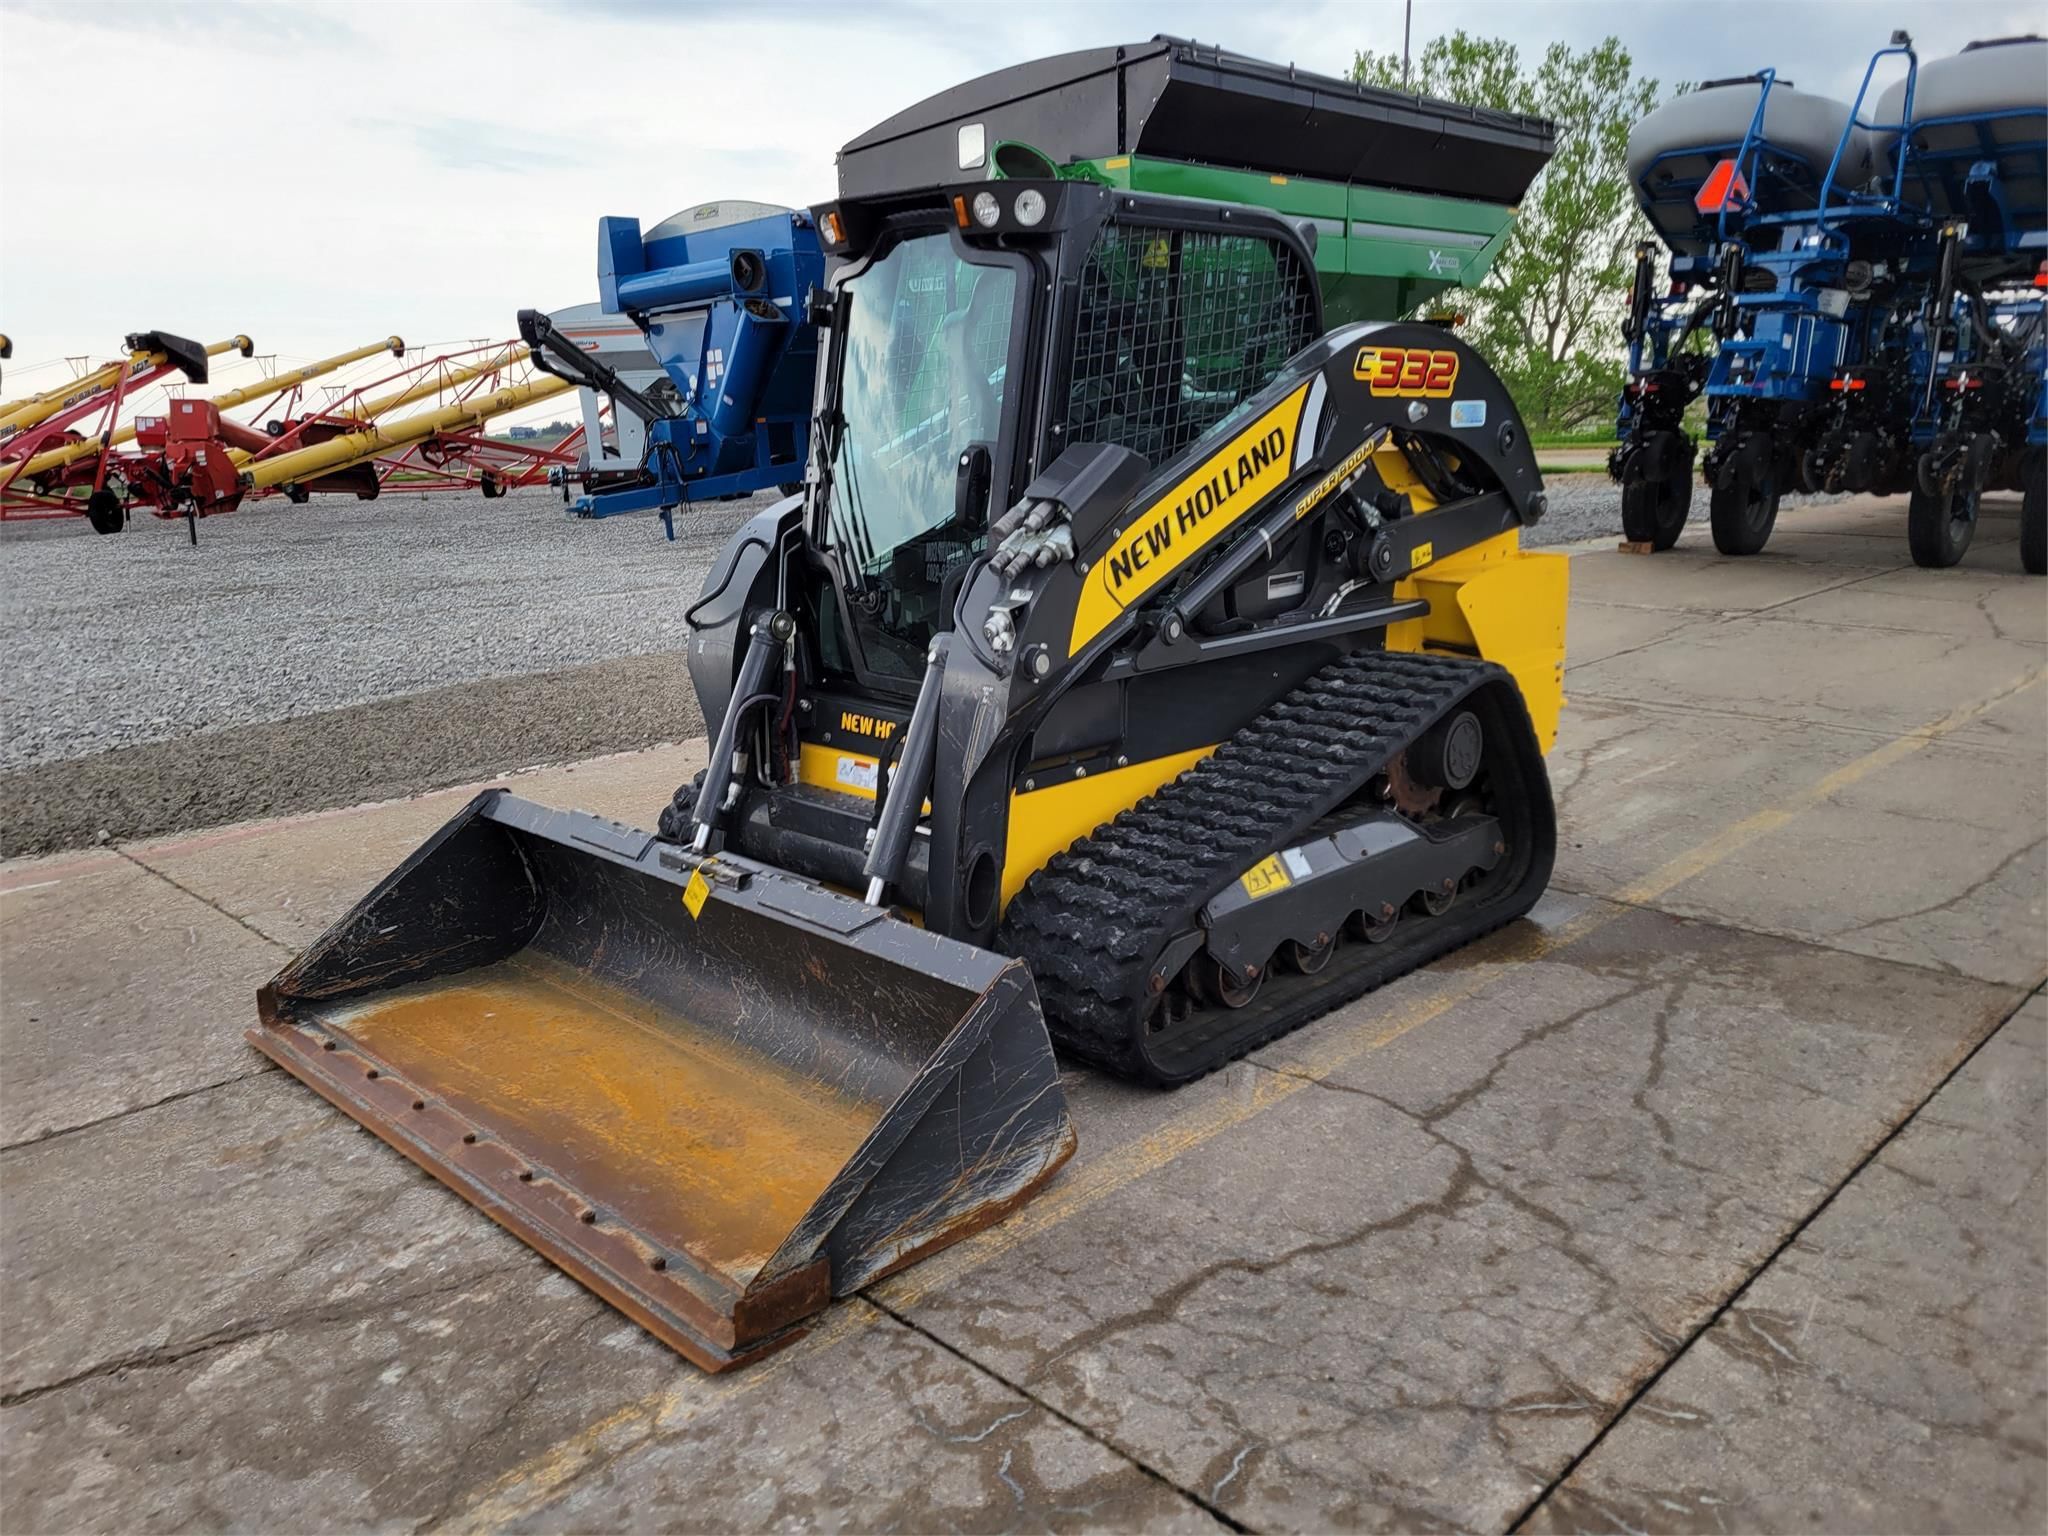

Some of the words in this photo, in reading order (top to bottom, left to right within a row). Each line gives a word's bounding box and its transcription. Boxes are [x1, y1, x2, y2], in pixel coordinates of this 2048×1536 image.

[1354, 347, 1458, 396] C332
[1109, 514, 1171, 588] NEW
[1175, 427, 1285, 536] HOLLAND
[1296, 473, 1337, 516] SUPER
[1340, 442, 1373, 477] BOOM
[841, 712, 874, 736] NEW
